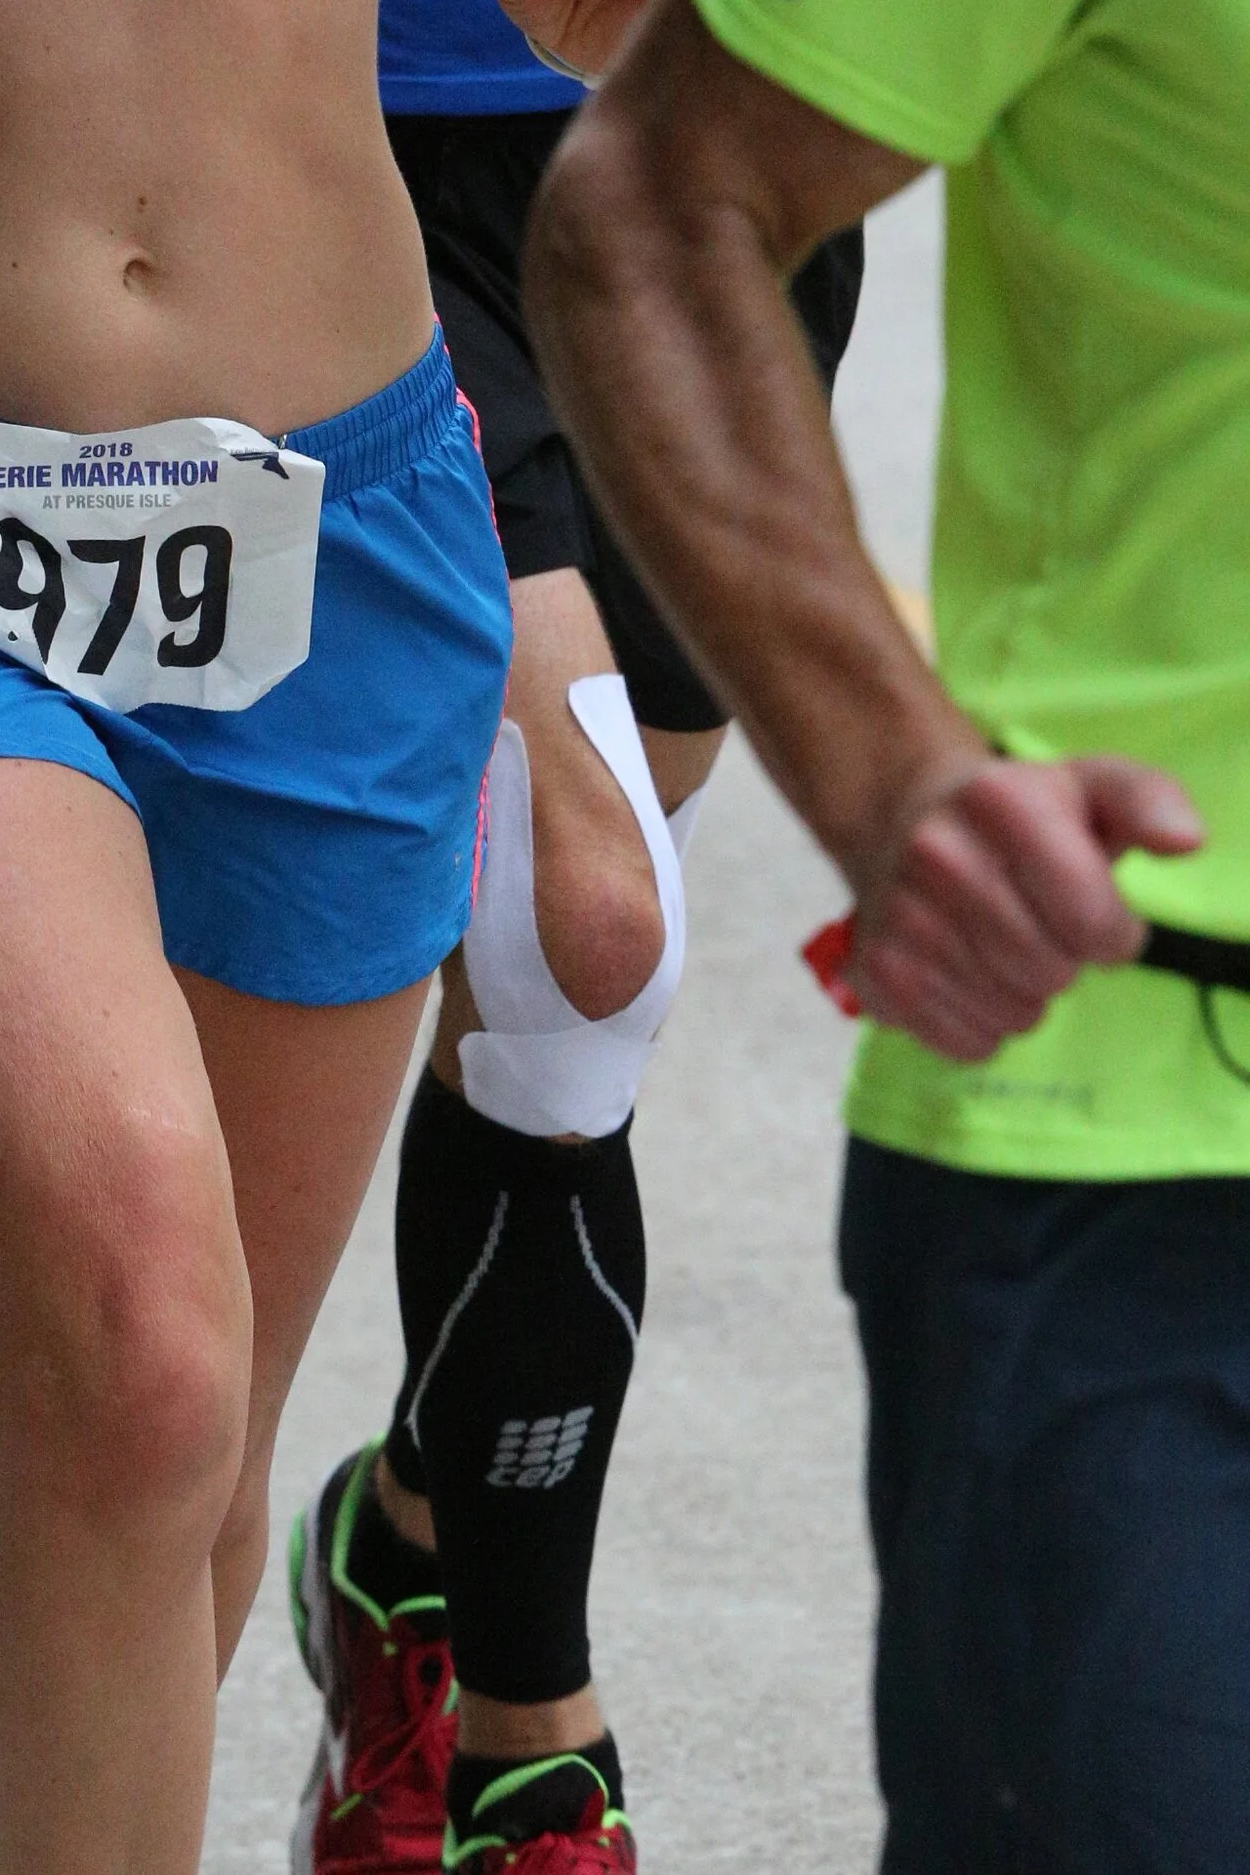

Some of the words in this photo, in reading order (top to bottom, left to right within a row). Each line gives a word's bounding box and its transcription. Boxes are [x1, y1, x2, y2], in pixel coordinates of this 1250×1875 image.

[79, 442, 134, 459] 2018
[61, 460, 219, 488] MARATHON
[42, 494, 61, 511] AT
[66, 494, 135, 511] PRESQUE
[139, 493, 172, 509] ISLE
